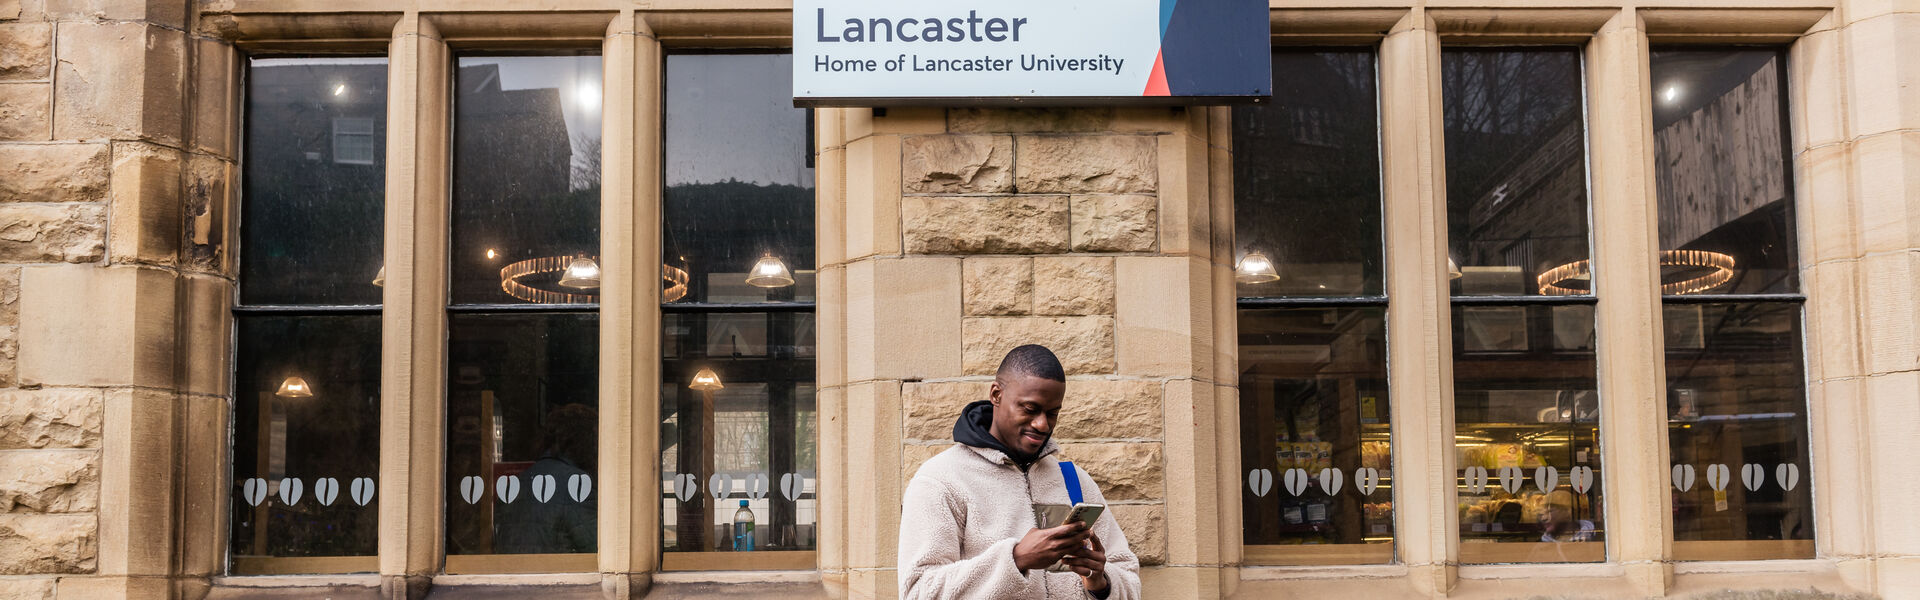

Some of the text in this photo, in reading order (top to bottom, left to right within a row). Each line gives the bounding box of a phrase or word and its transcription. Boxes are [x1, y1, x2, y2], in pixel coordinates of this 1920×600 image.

[817, 8, 1028, 43] Lancaster
[814, 53, 1125, 76] Home of Lancaster University
